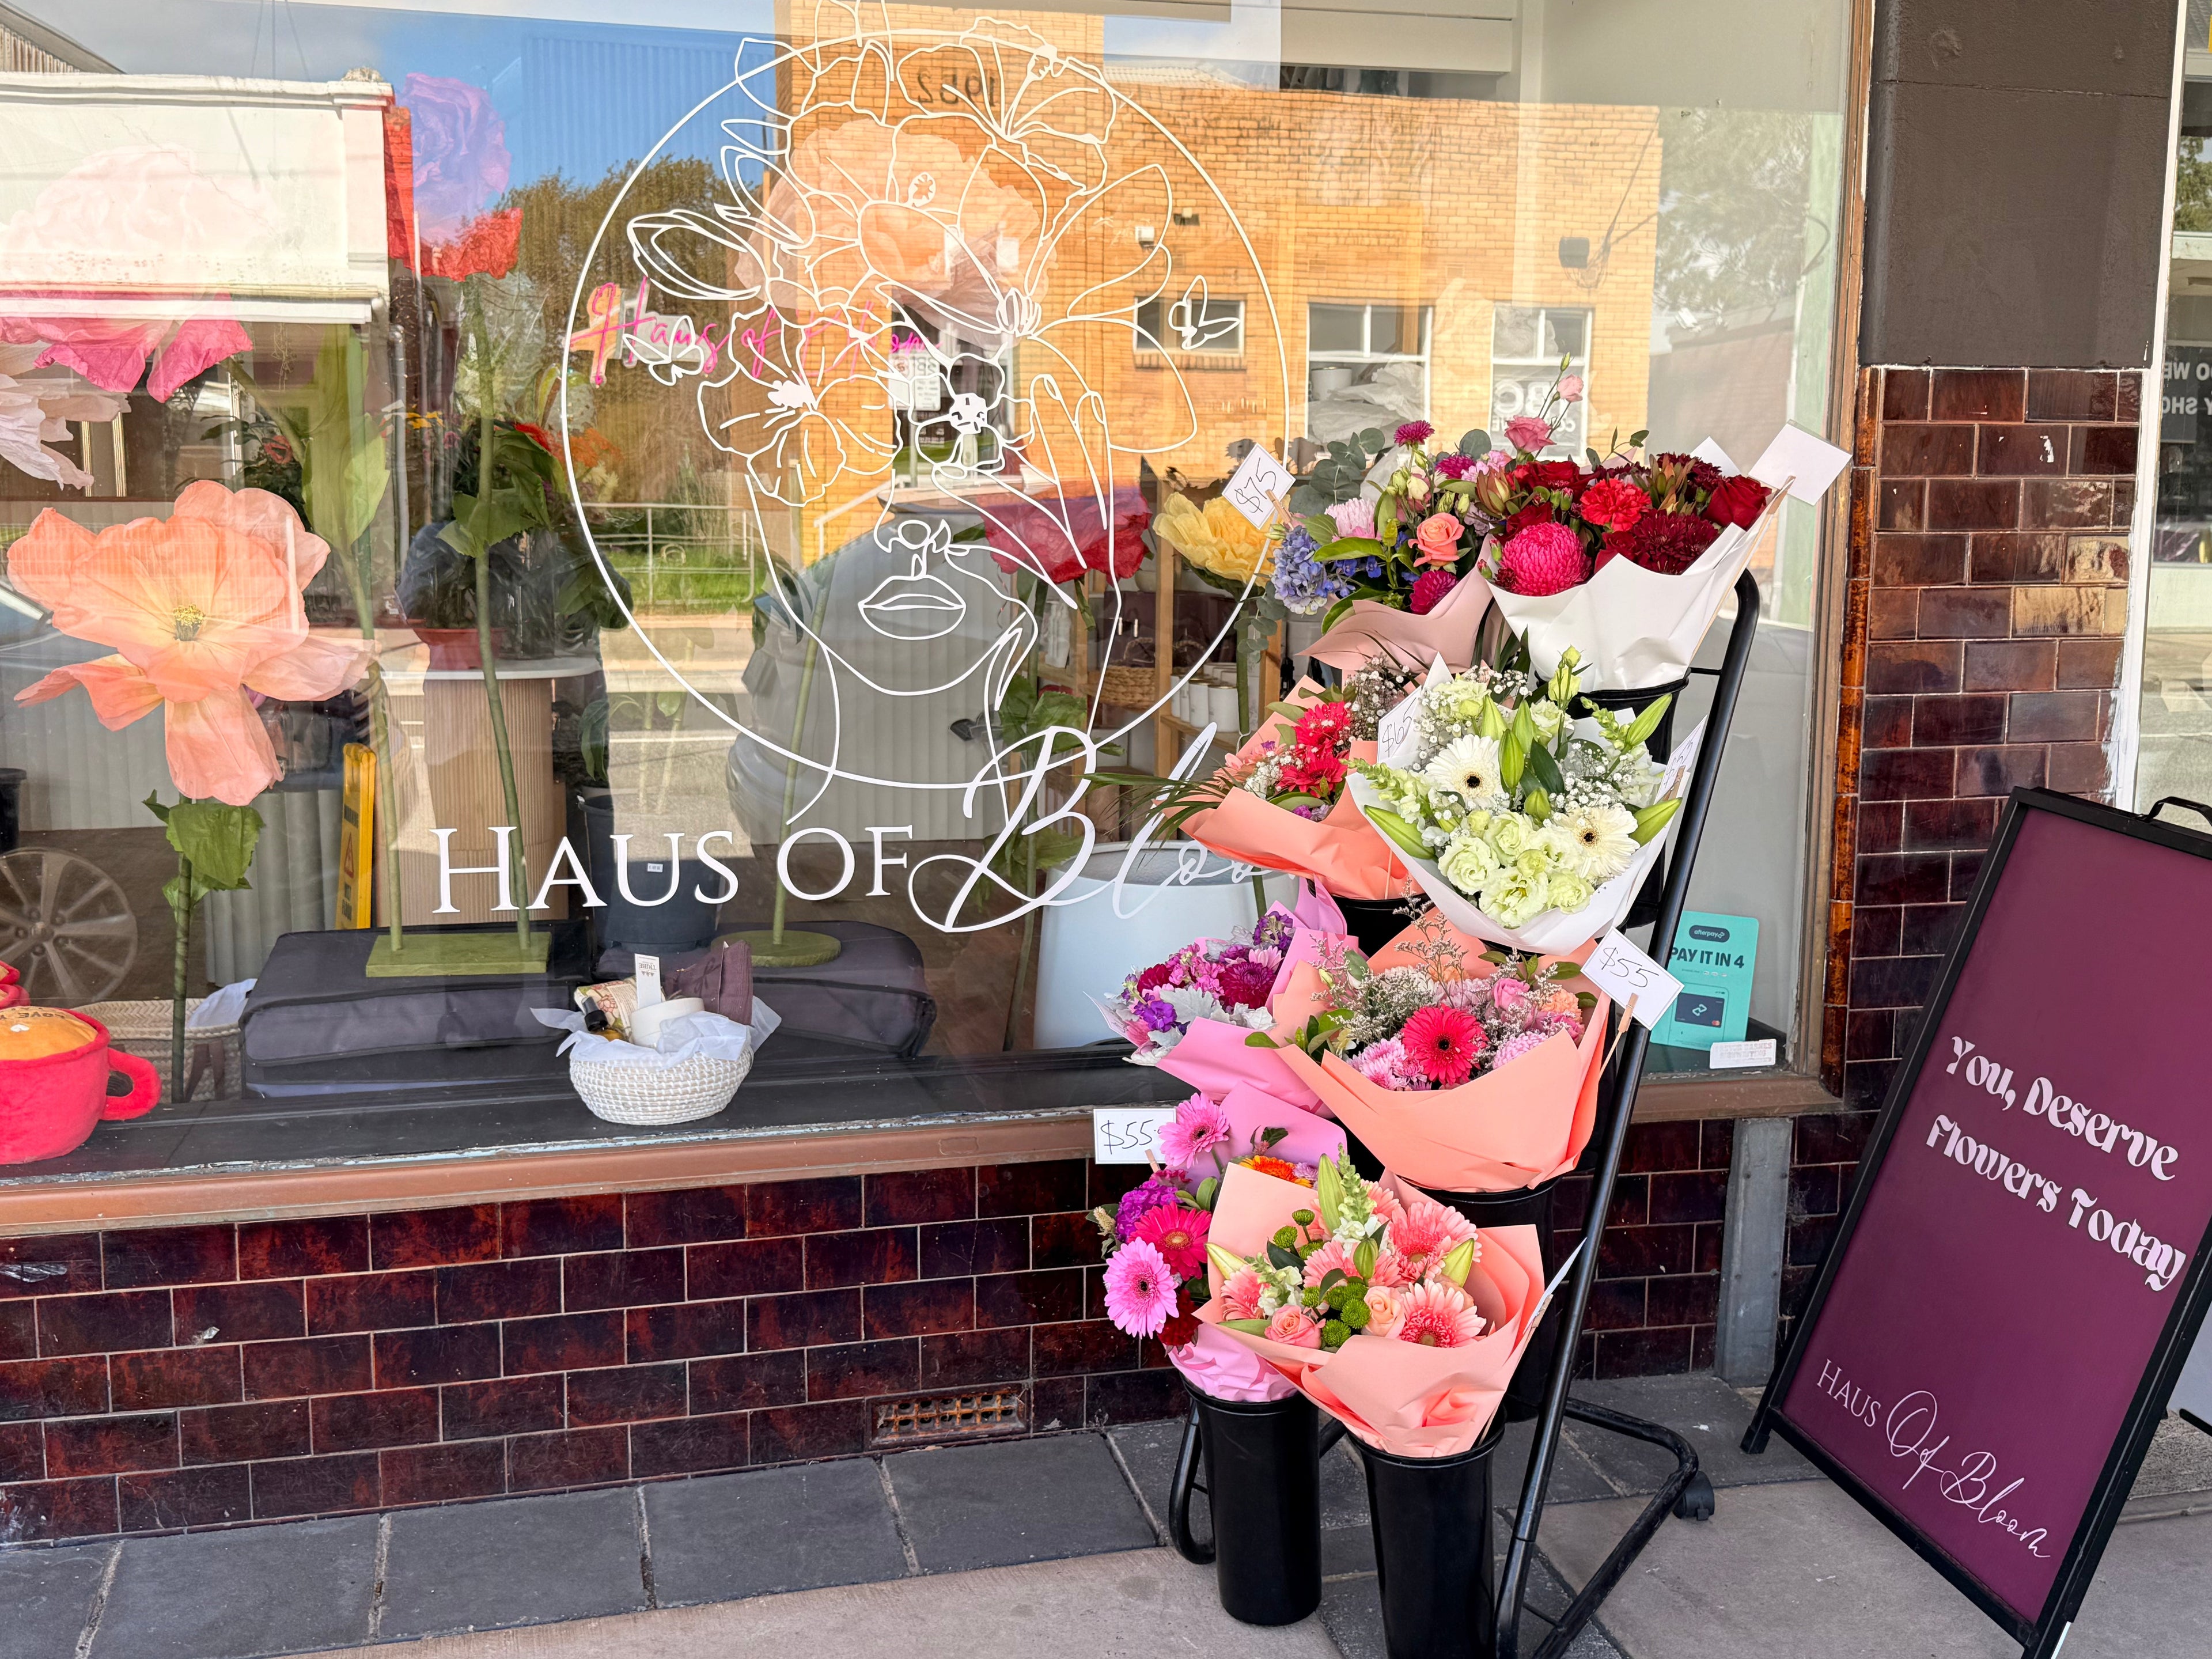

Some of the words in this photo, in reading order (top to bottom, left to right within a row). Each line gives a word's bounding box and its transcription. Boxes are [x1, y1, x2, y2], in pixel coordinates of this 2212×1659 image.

[1234, 457, 1277, 513] $75
[1382, 697, 1417, 757] $65
[429, 825, 739, 914] HAUS
[777, 824, 914, 901] OF
[1672, 947, 1698, 962] PAY
[1700, 950, 1713, 964] IT
[1715, 952, 1731, 967] IN
[1733, 955, 1744, 968] 4
[1694, 929, 1718, 938] afterpay
[1599, 947, 1660, 988] $55
[1946, 1036, 2016, 1111] You,
[2023, 1077, 2179, 1180] Deserve
[1926, 1115, 2062, 1212] Flowers
[2069, 1188, 2187, 1291] Today
[1816, 1359, 1881, 1427] HAUS
[1887, 1390, 1950, 1490] Of
[1940, 1452, 2051, 1558] Bloom
